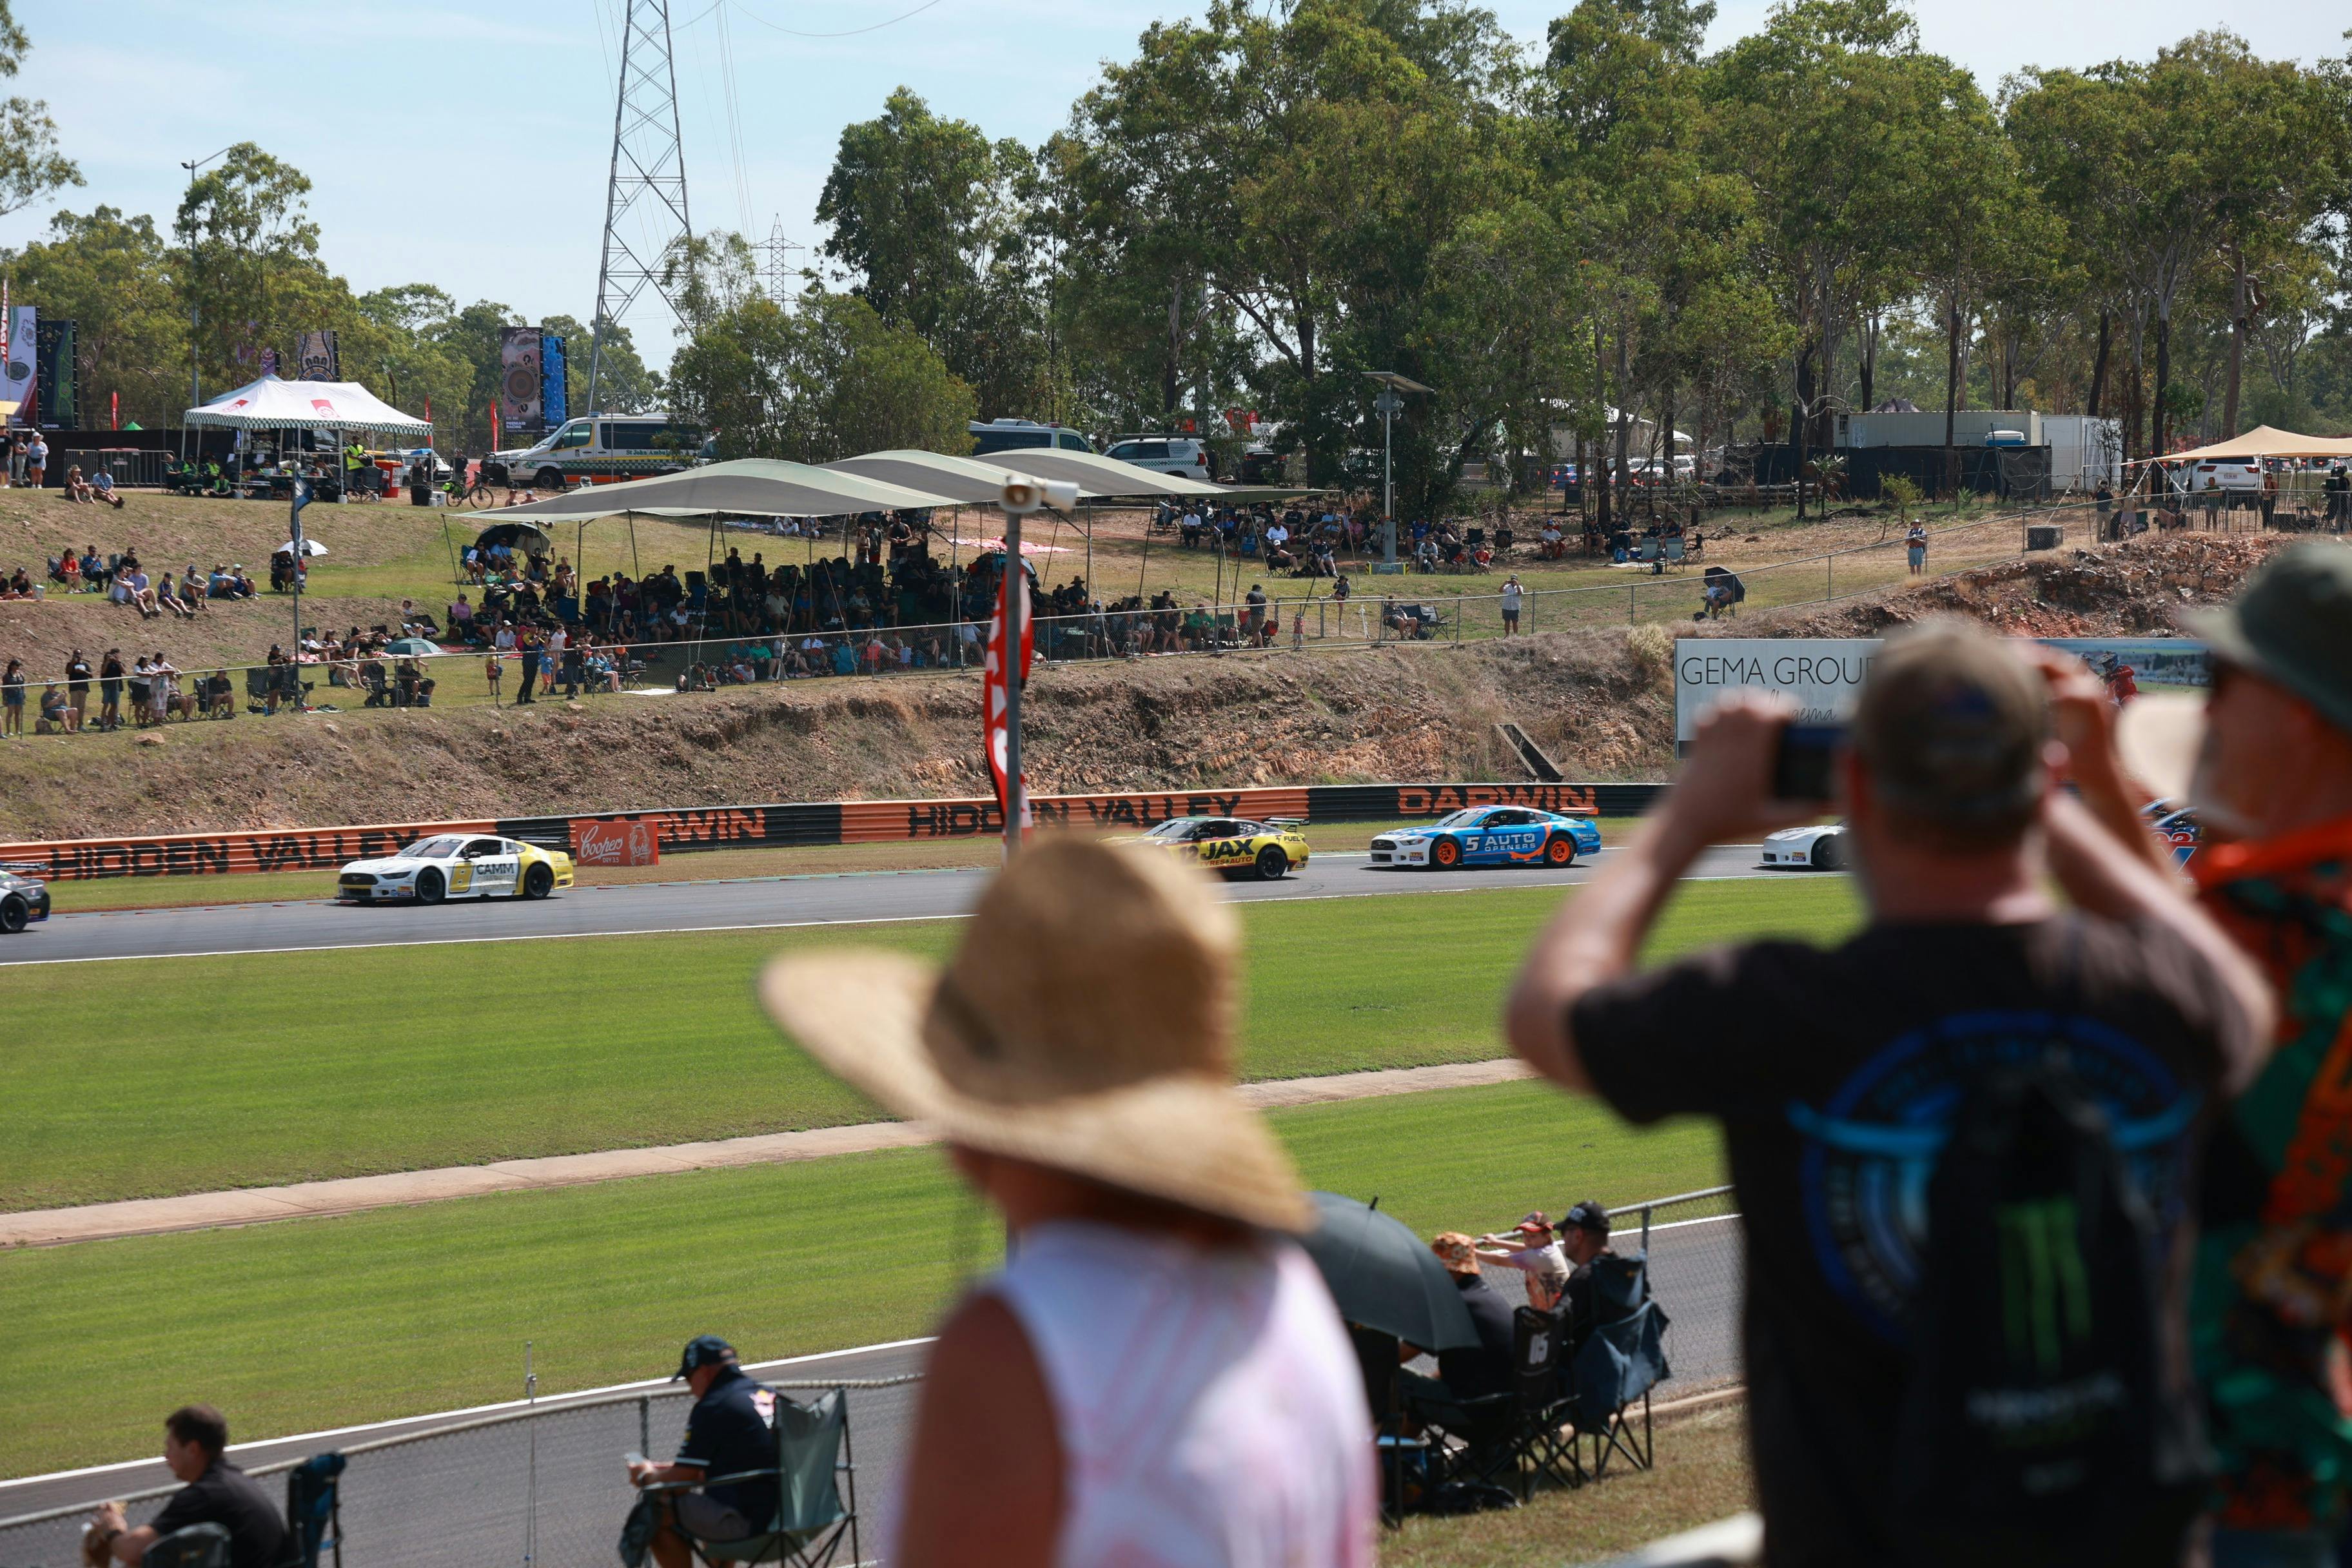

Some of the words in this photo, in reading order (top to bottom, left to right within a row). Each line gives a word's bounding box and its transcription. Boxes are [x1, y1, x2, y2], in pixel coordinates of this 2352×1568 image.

[1681, 656, 1765, 685] GEMA
[1398, 786, 1596, 814] DARWIN
[580, 825, 623, 860] Coopers
[1200, 838, 1255, 860] JAX
[1465, 836, 1480, 851] 5
[1485, 833, 1535, 846] AUTO
[1485, 843, 1536, 852] OPENERS
[50, 839, 228, 881] HIDDEN
[246, 830, 419, 870] VALLEY
[1200, 857, 1225, 867] TYRES
[476, 863, 514, 875] CAMM
